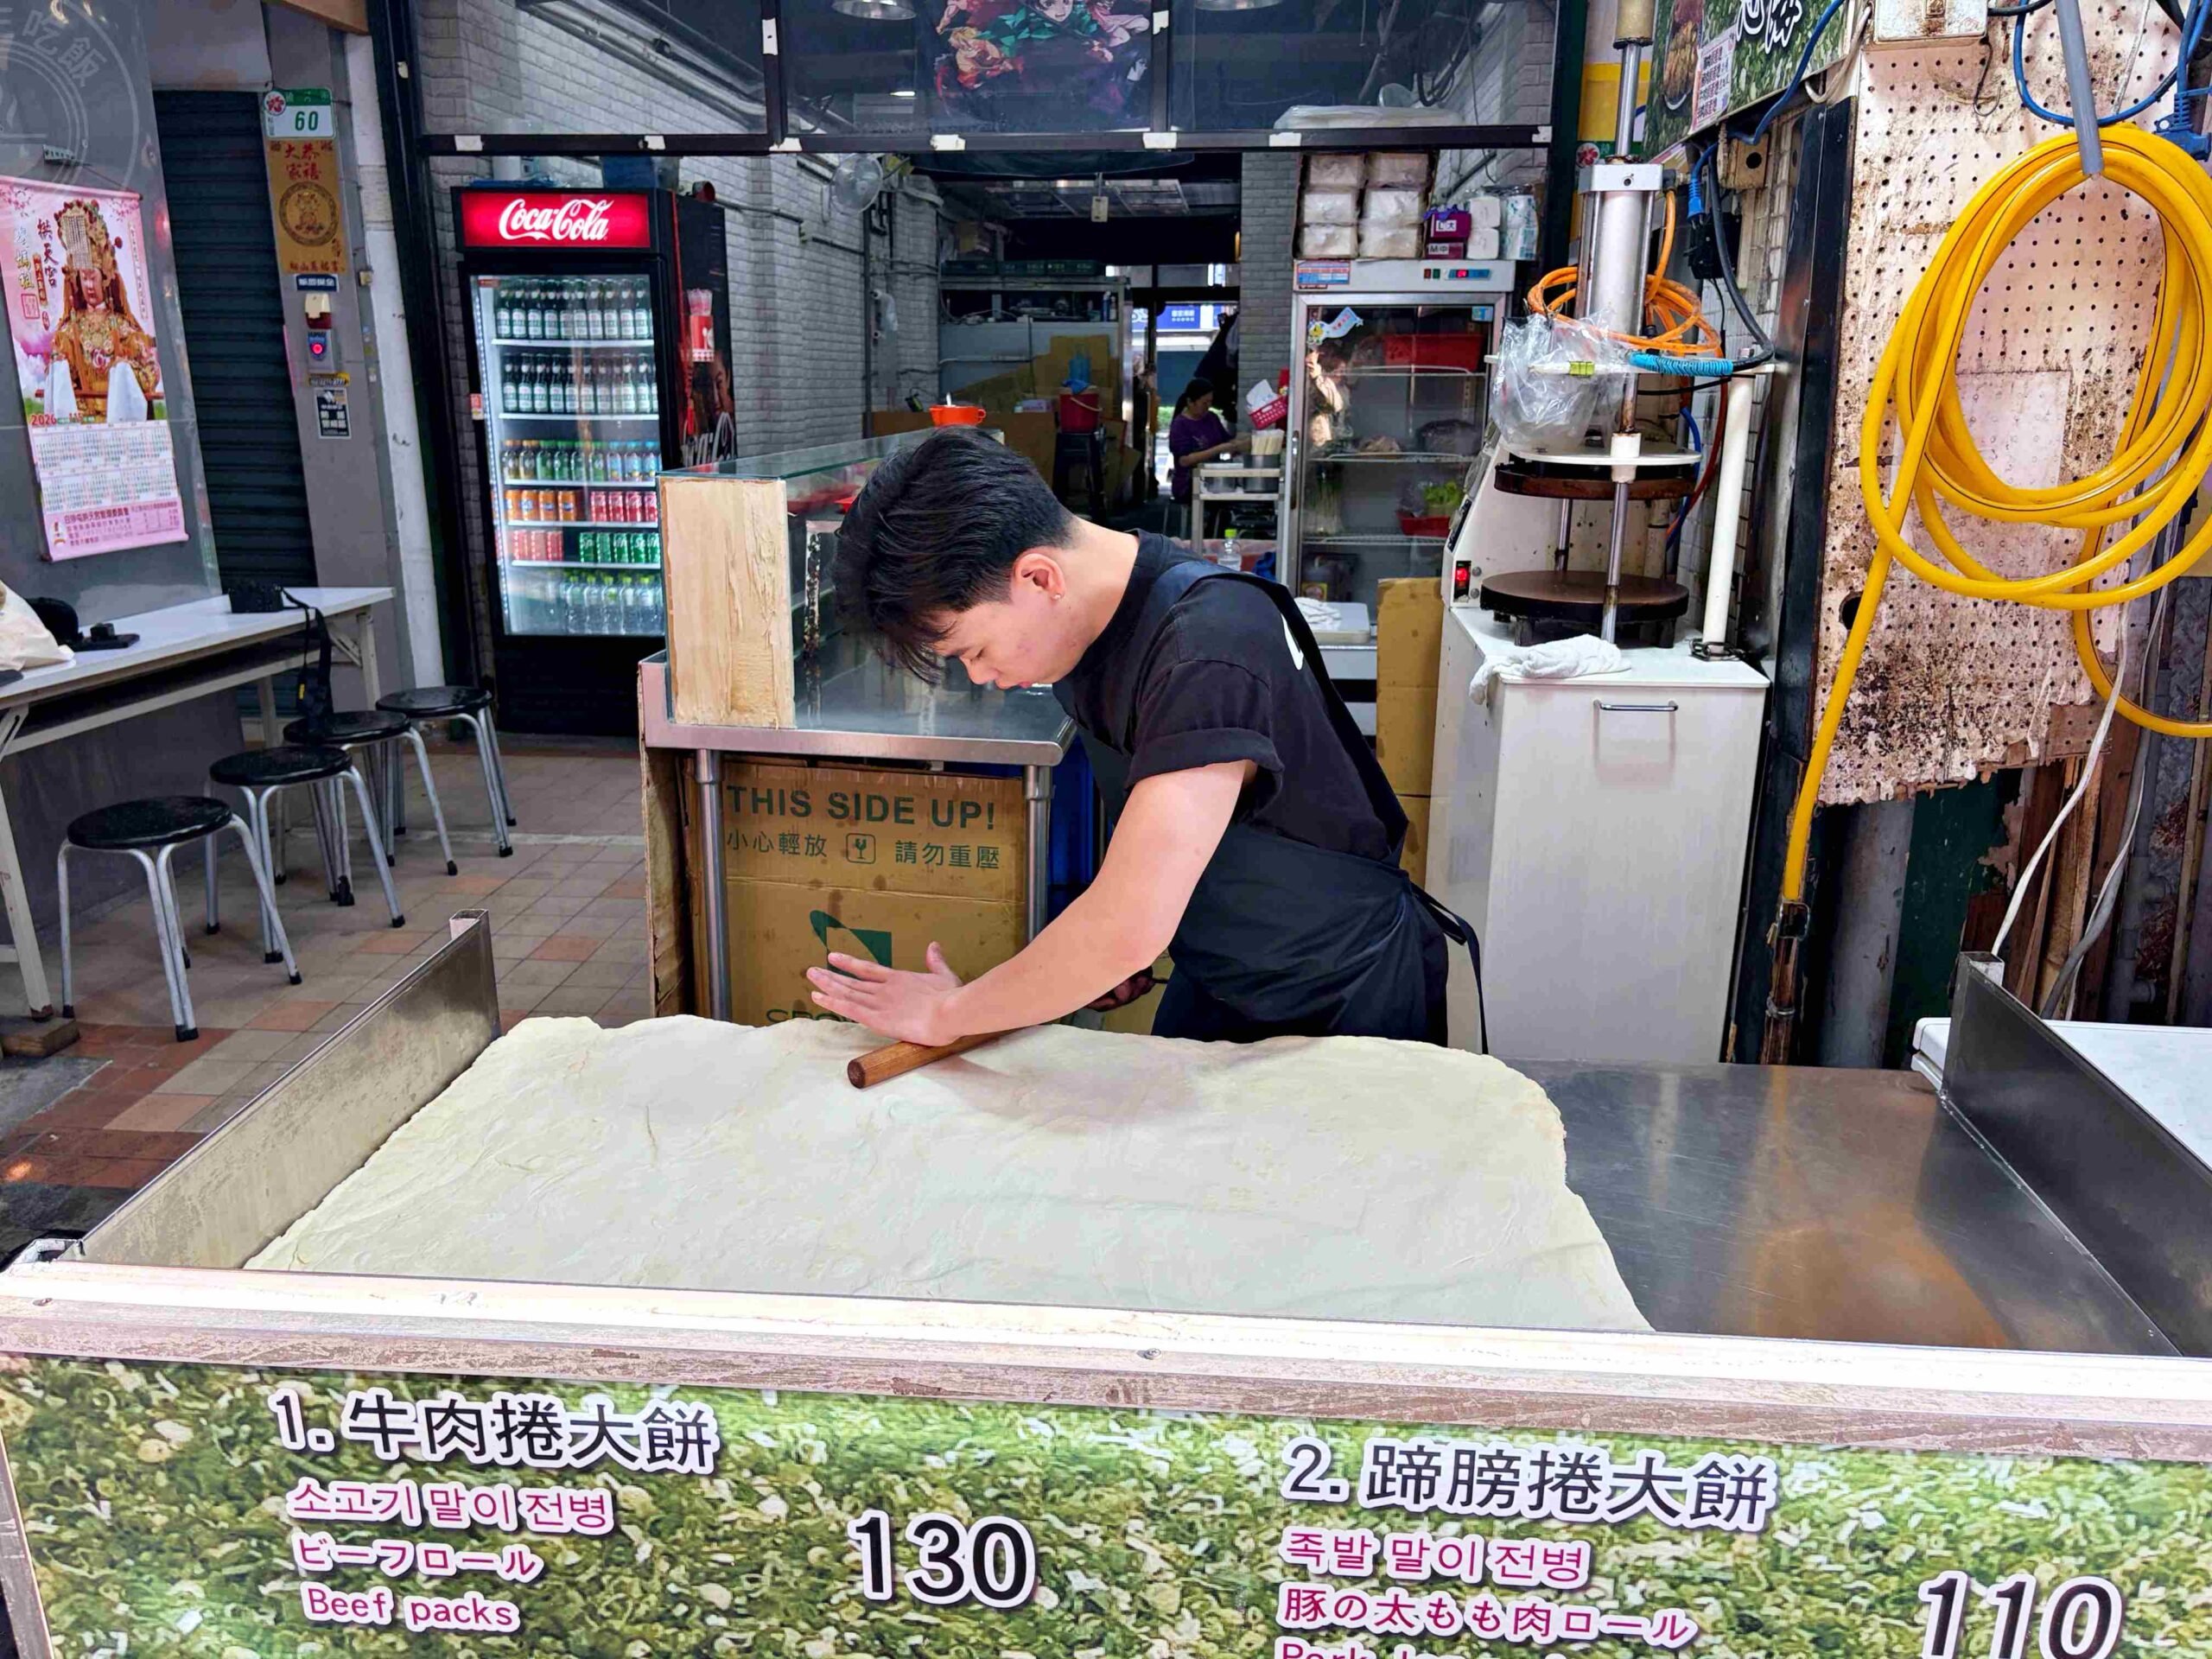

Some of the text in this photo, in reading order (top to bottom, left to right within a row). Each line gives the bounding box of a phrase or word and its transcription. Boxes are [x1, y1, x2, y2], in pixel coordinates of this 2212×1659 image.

[295, 111, 319, 131] 60
[499, 198, 615, 240] Coca-Cola
[30, 413, 57, 427] 2026
[727, 785, 995, 830] THIS SIDE UP!
[726, 830, 1001, 870] 小心輕放 請勿重壓
[292, 1483, 607, 1528] 소고기 말이 전병
[299, 1536, 537, 1579] ビーフロール
[855, 1516, 1027, 1602] 130
[1287, 1532, 1583, 1583] 족발 말이 전병
[307, 1586, 513, 1628] Beef packs
[1283, 1588, 1692, 1644] 豚の太もも肉ロール
[1927, 1577, 2114, 1659] 110
